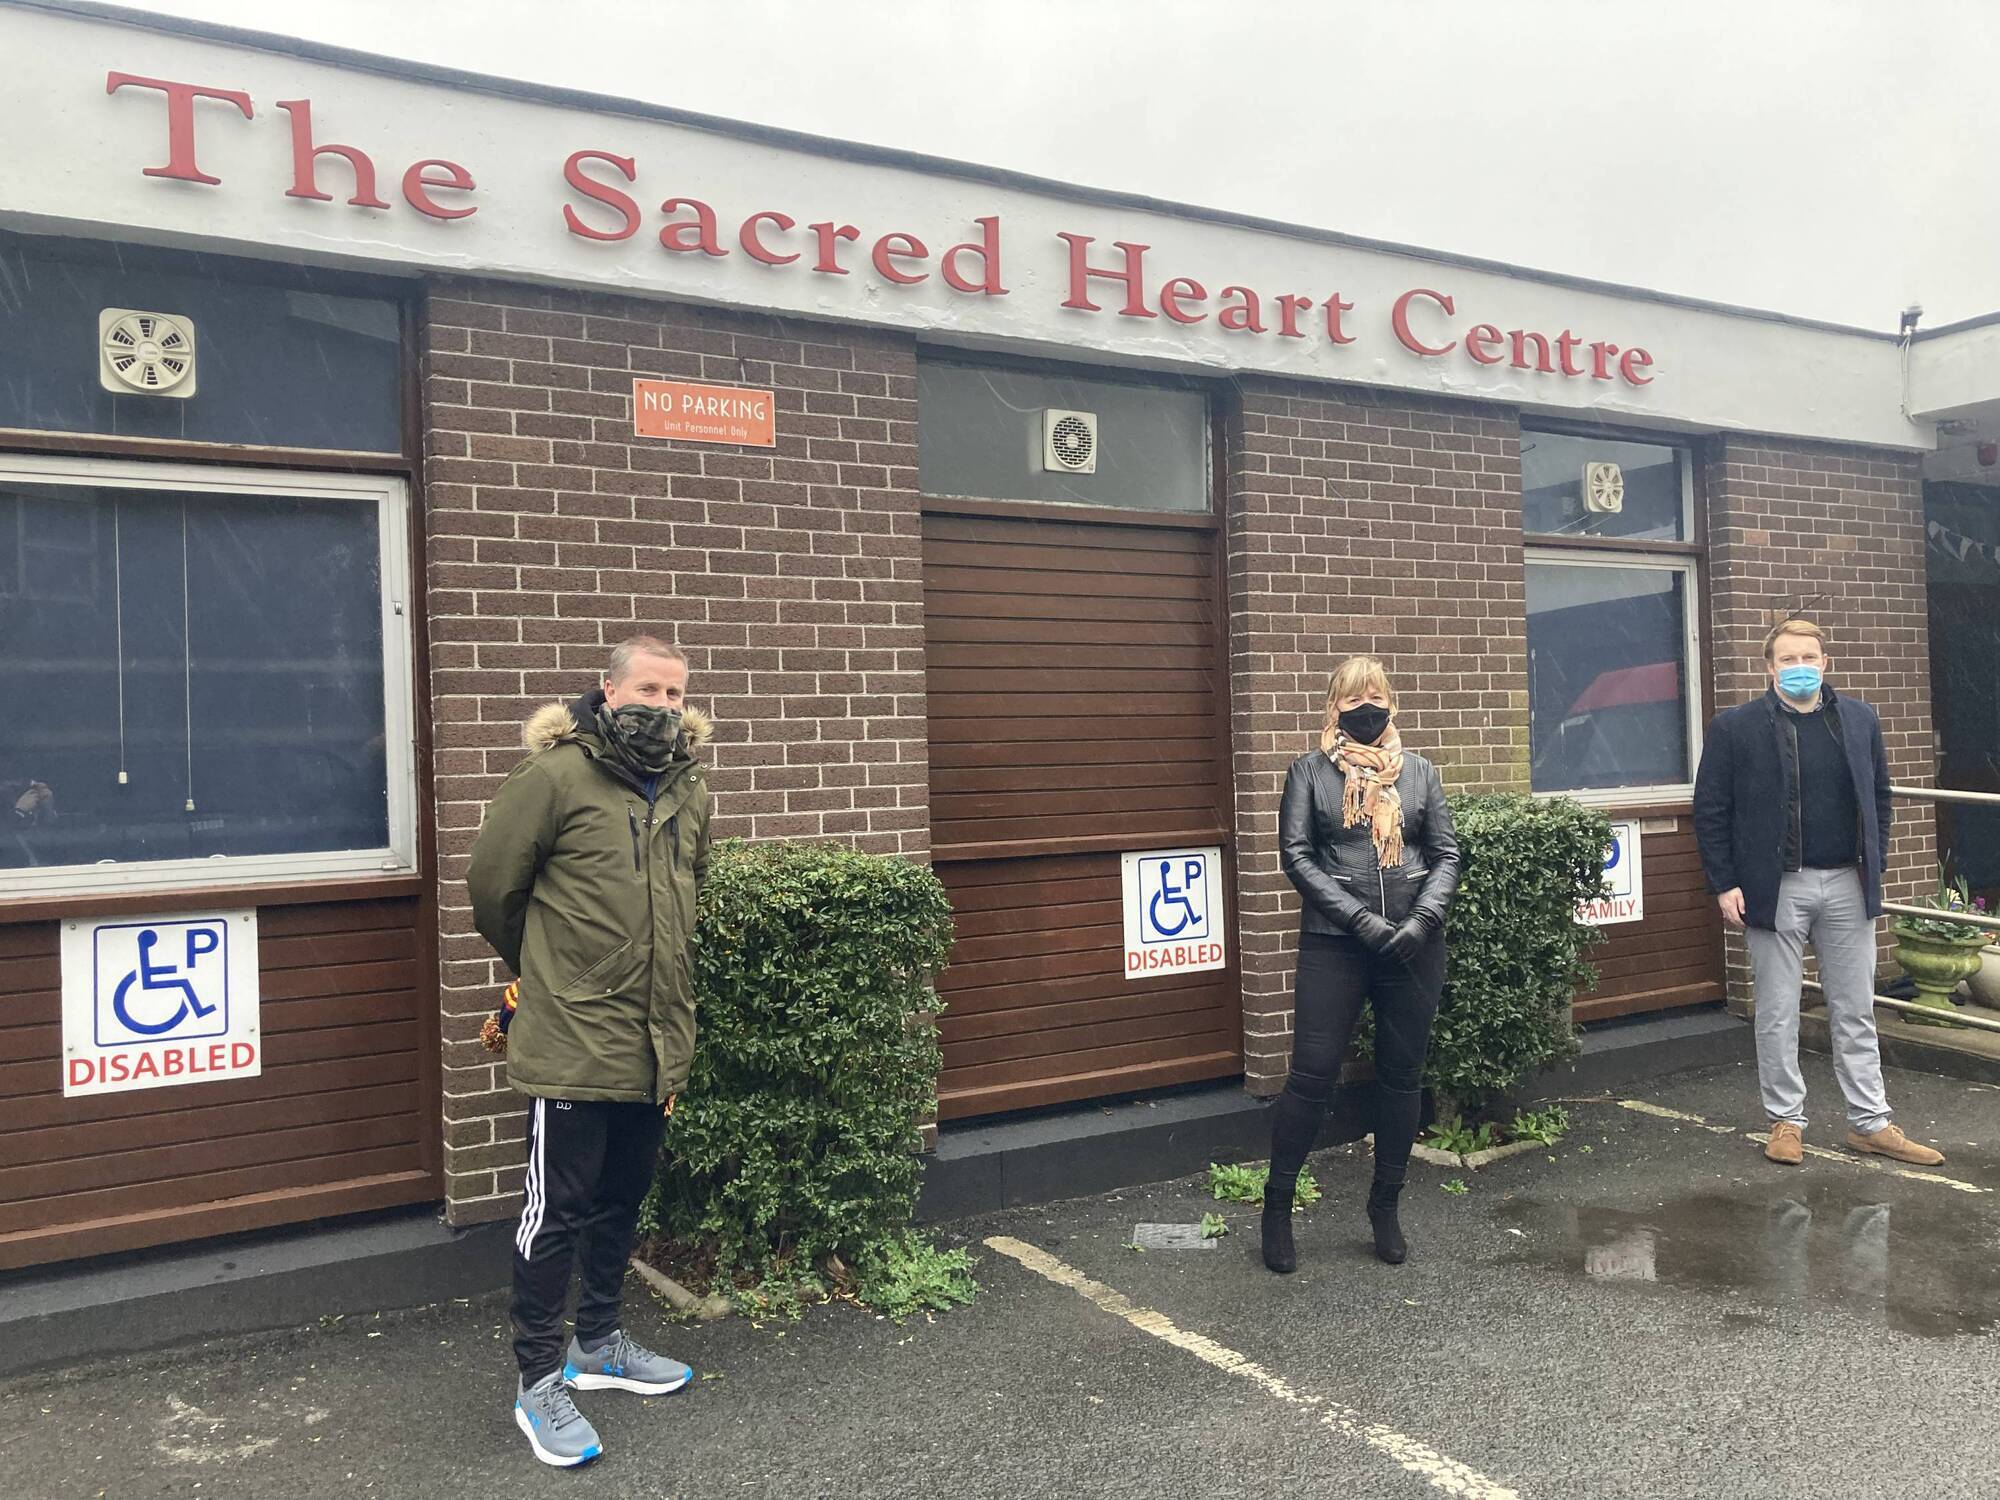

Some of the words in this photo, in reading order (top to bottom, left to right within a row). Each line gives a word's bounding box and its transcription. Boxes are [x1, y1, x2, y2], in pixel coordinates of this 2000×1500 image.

[106, 71, 478, 219] The
[563, 150, 1009, 295] Sacred
[1057, 232, 1357, 345] Heart
[1391, 289, 1655, 385] Centre
[644, 391, 672, 412] NO
[682, 395, 765, 421] PARKING
[664, 420, 681, 431] Unit
[685, 421, 727, 436] Personnel
[730, 425, 748, 440] Only
[1185, 861, 1202, 889] P
[186, 928, 219, 969] P
[1127, 943, 1223, 972] DISABLED
[69, 1042, 255, 1087] DISABLED
